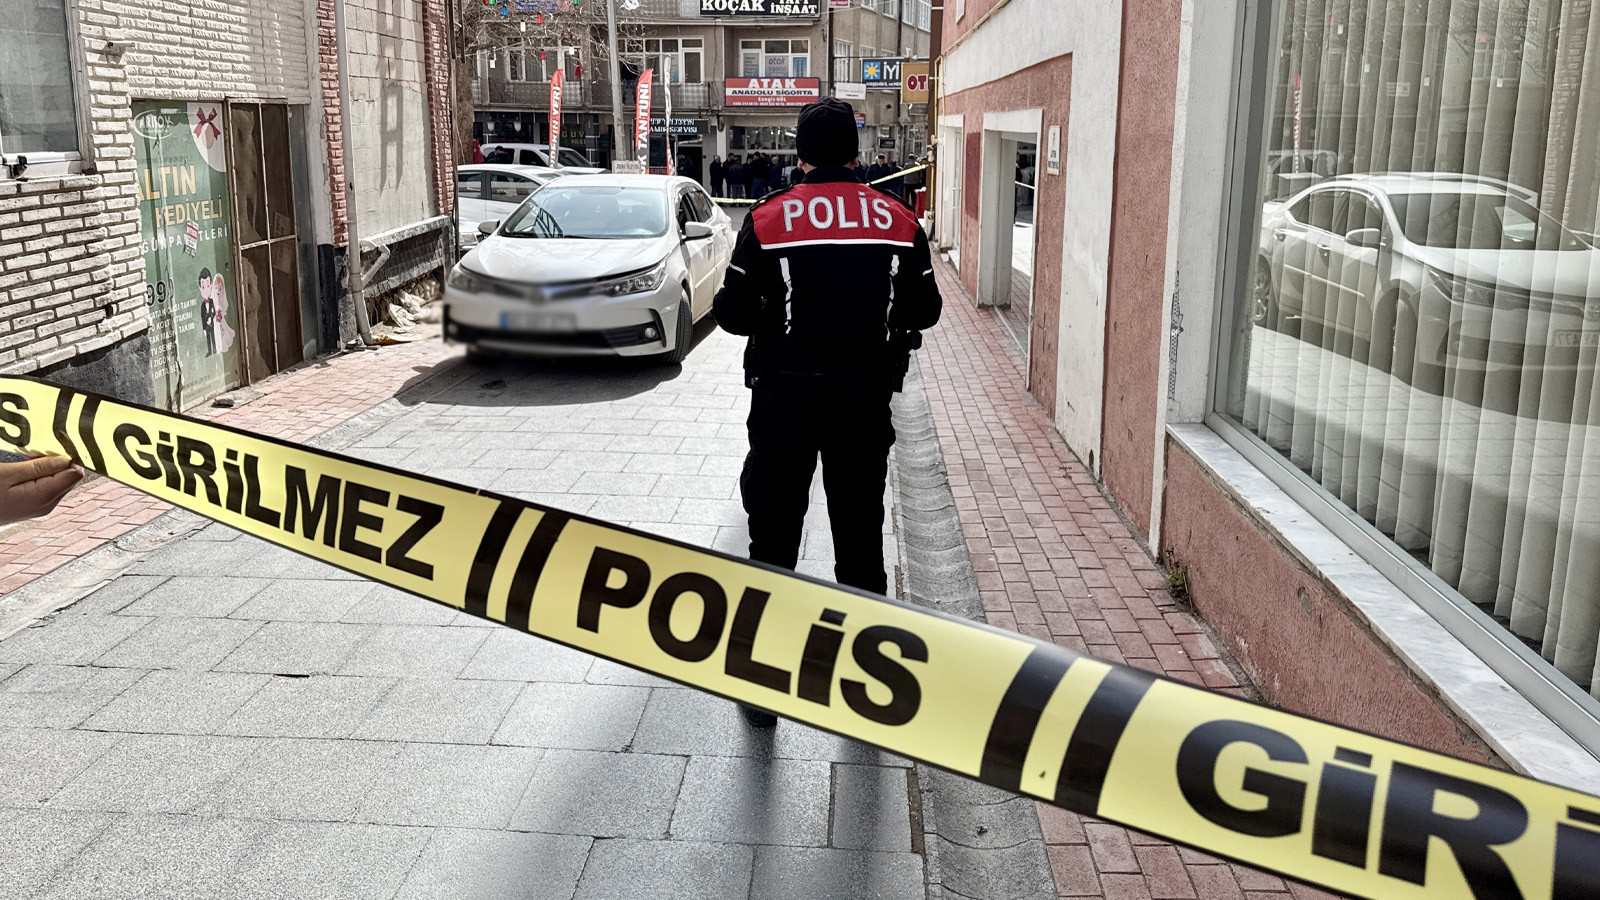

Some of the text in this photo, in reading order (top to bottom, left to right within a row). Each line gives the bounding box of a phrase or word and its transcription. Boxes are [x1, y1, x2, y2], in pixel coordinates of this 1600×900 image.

[701, 0, 765, 14] KOÇAK
[770, 3, 817, 15] İNŞAAT
[748, 78, 797, 89] ATAK
[907, 74, 929, 91] OT
[155, 194, 223, 228] HEDİYELİ
[782, 191, 893, 233] POLİS
[169, 224, 228, 248] PATLERİ
[112, 422, 445, 581] GİRİLMEZ
[576, 546, 929, 726] POLİS
